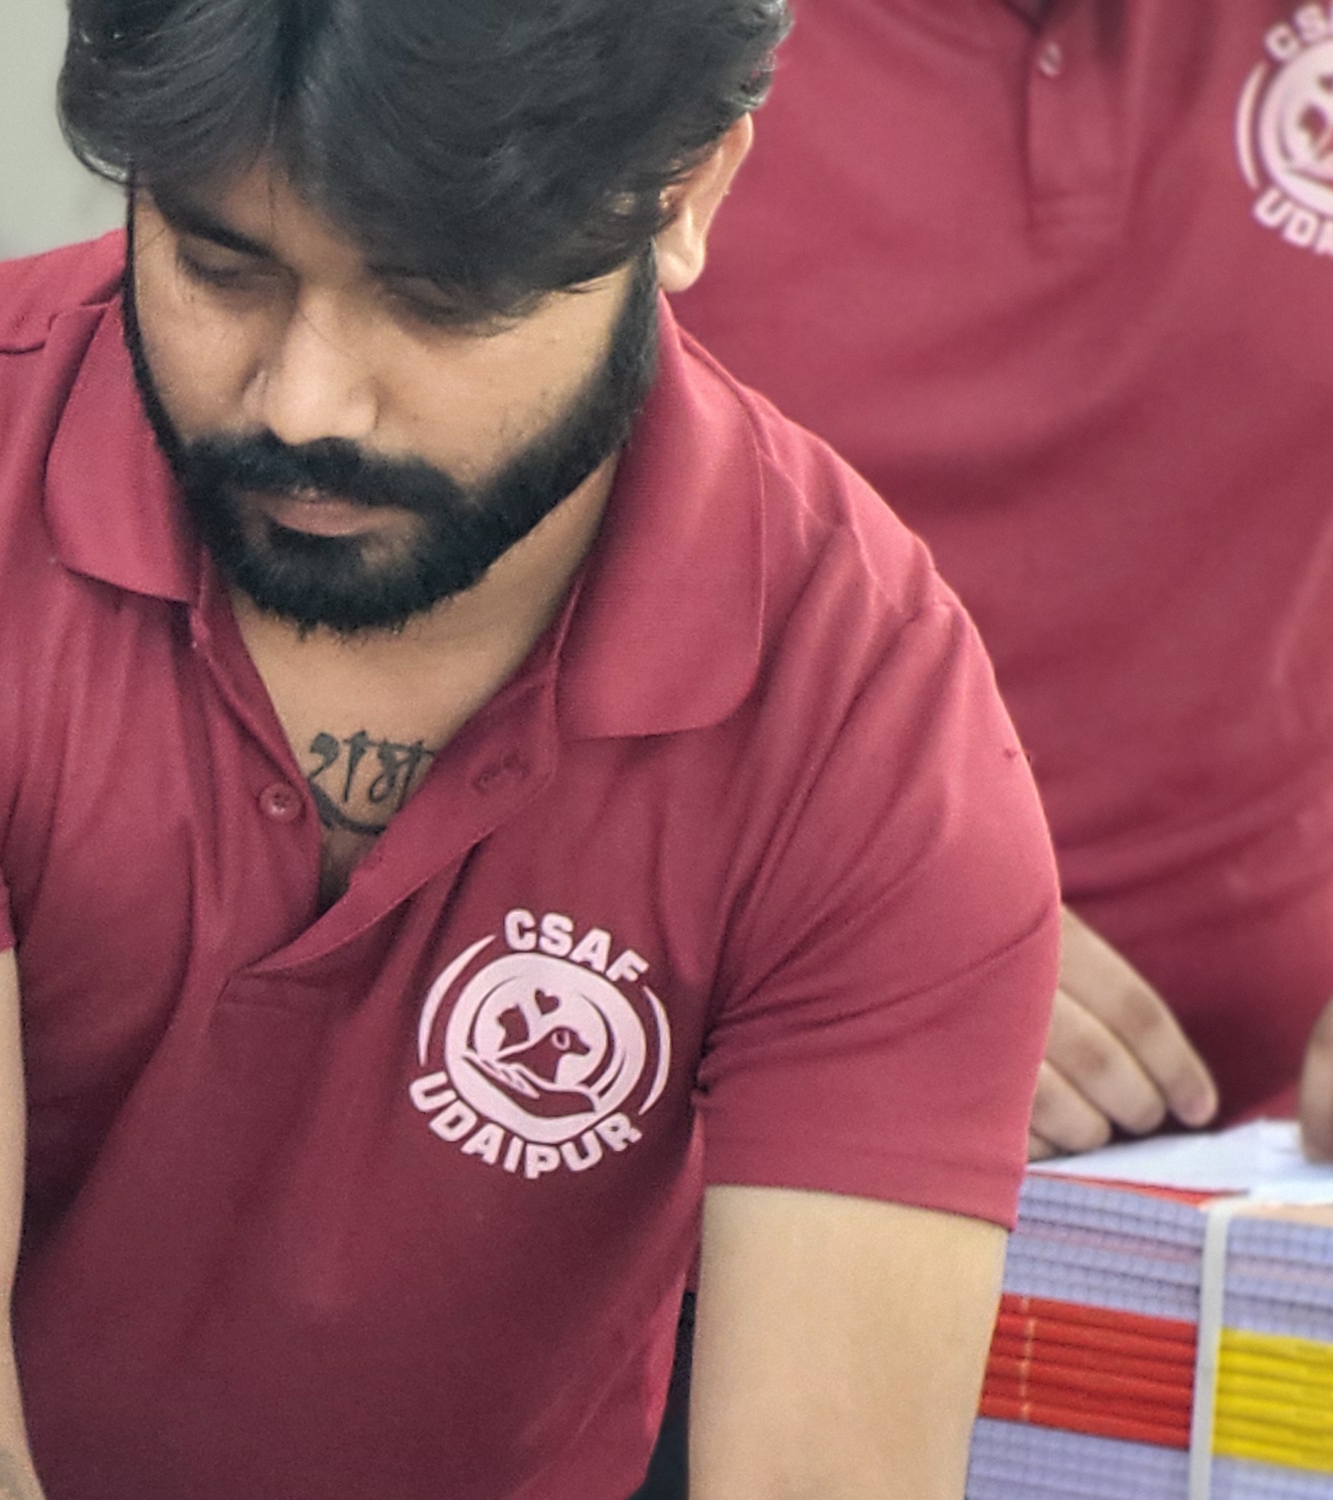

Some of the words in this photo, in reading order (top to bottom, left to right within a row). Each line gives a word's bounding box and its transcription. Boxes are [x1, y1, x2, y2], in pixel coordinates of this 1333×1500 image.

[1264, 2, 1333, 62] CS
[504, 908, 649, 985] CSAF
[408, 1071, 642, 1180] UDAIPUR
